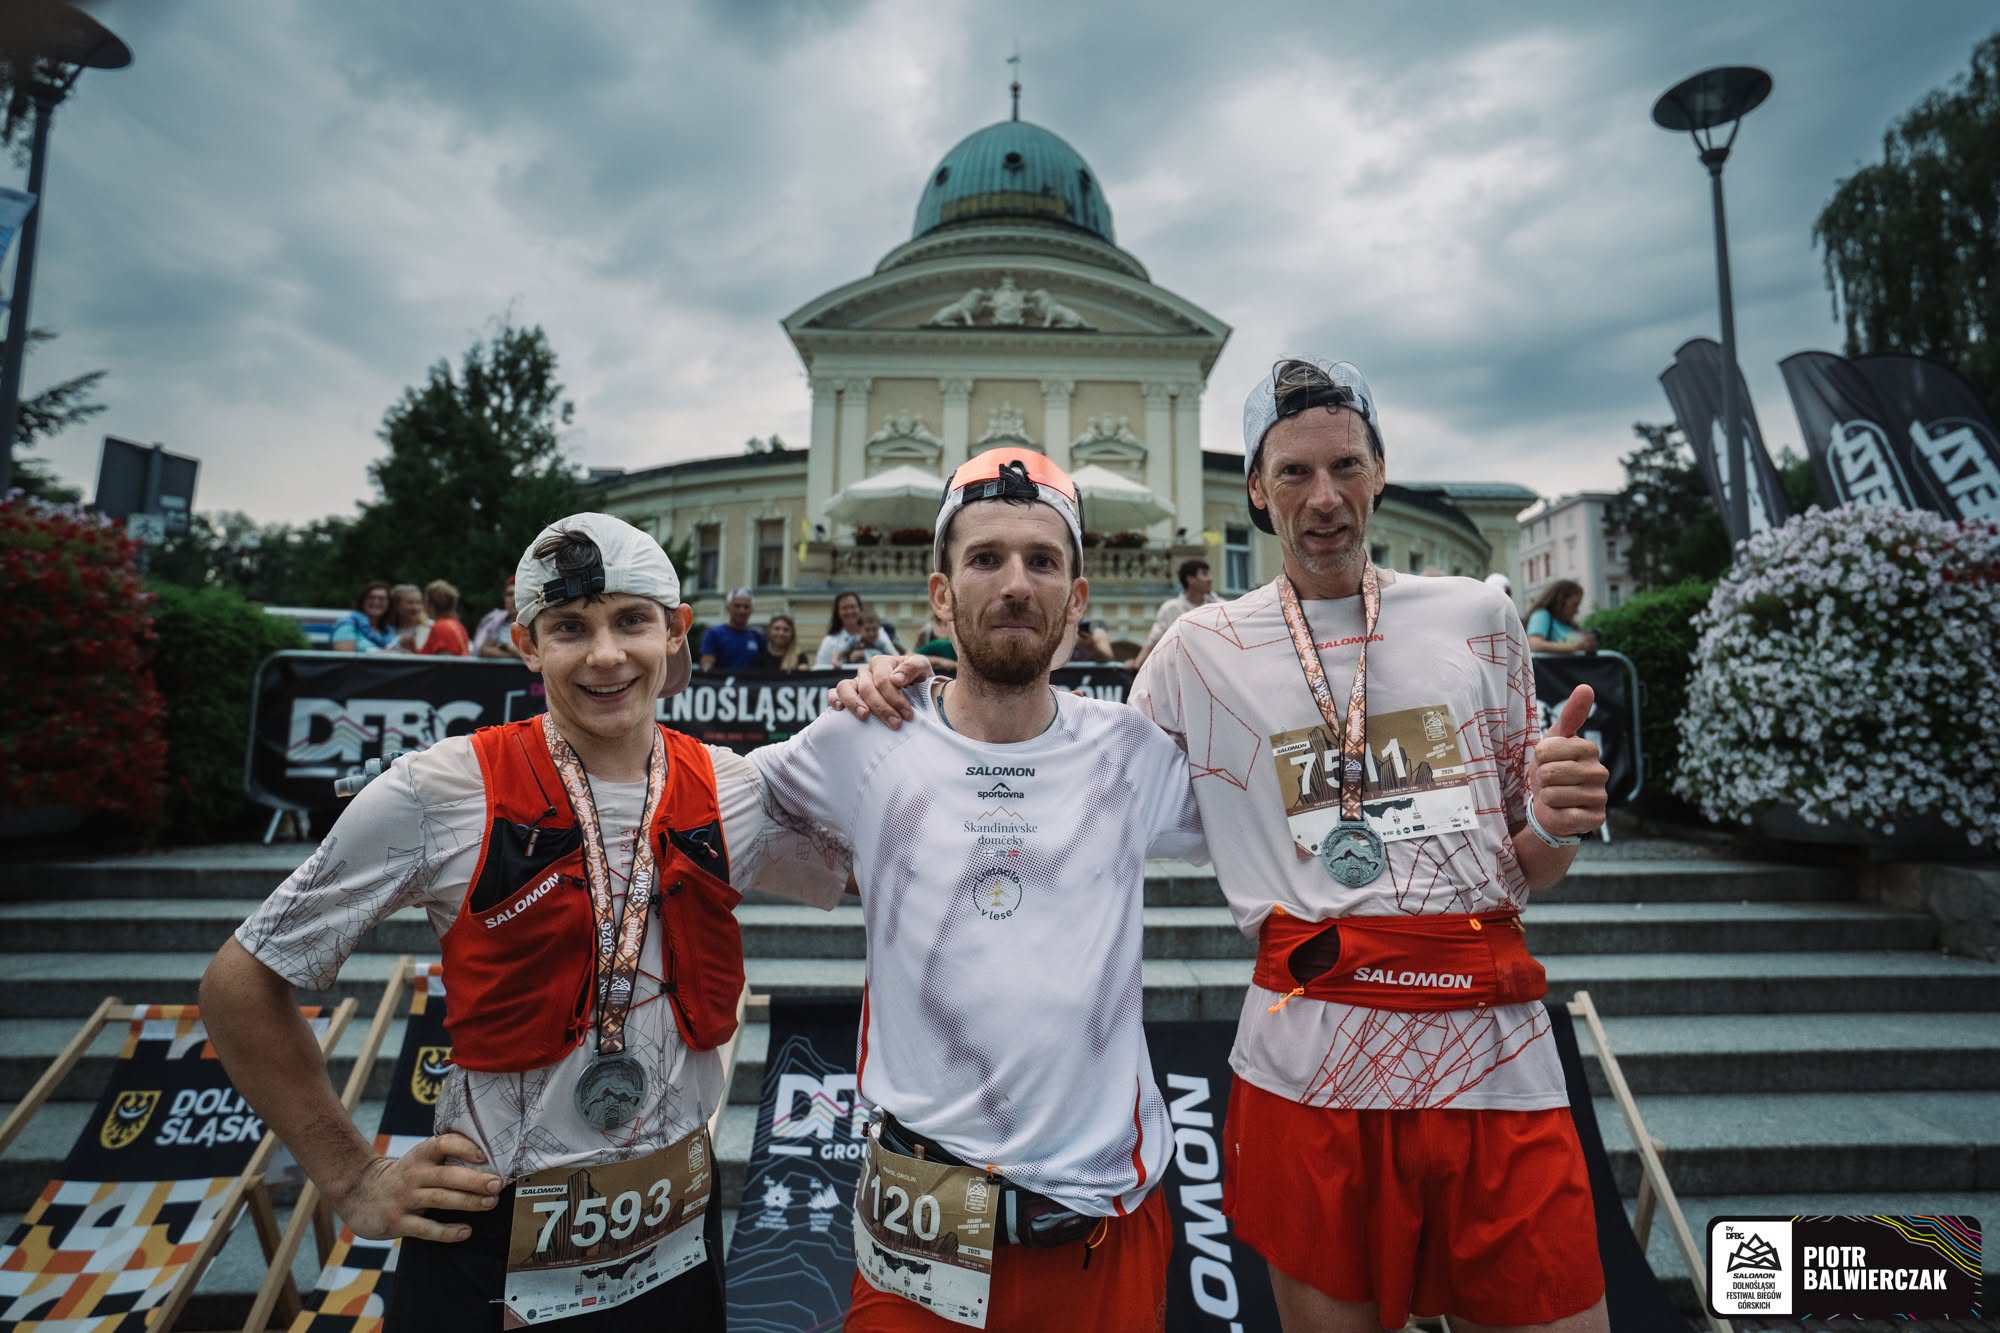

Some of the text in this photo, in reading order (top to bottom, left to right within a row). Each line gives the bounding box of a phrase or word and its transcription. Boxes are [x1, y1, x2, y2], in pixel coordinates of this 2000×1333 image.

[656, 676, 829, 731] LNOŚLĄSKI
[1313, 676, 1330, 704] 33KM
[1276, 742, 1307, 754] SALOMON
[965, 766, 1036, 777] SALOMON
[1290, 738, 1407, 796] 7511
[977, 790, 1025, 800] sportovna
[963, 820, 1038, 833] Škandinávske
[977, 834, 1024, 846] domčeky
[485, 872, 561, 930] SALOMON
[632, 871, 649, 903] 33KM
[989, 909, 1013, 921] lese
[600, 922, 613, 954] 2026
[1353, 967, 1473, 989] SALOMON
[168, 1087, 254, 1116] DOL
[771, 1073, 870, 1139] DF
[154, 1110, 264, 1148] ŚLĄSK
[820, 1144, 867, 1160] GRO
[520, 1187, 564, 1196] SALOMON
[1166, 1073, 1244, 1333] OMON
[532, 1178, 672, 1253] 7593
